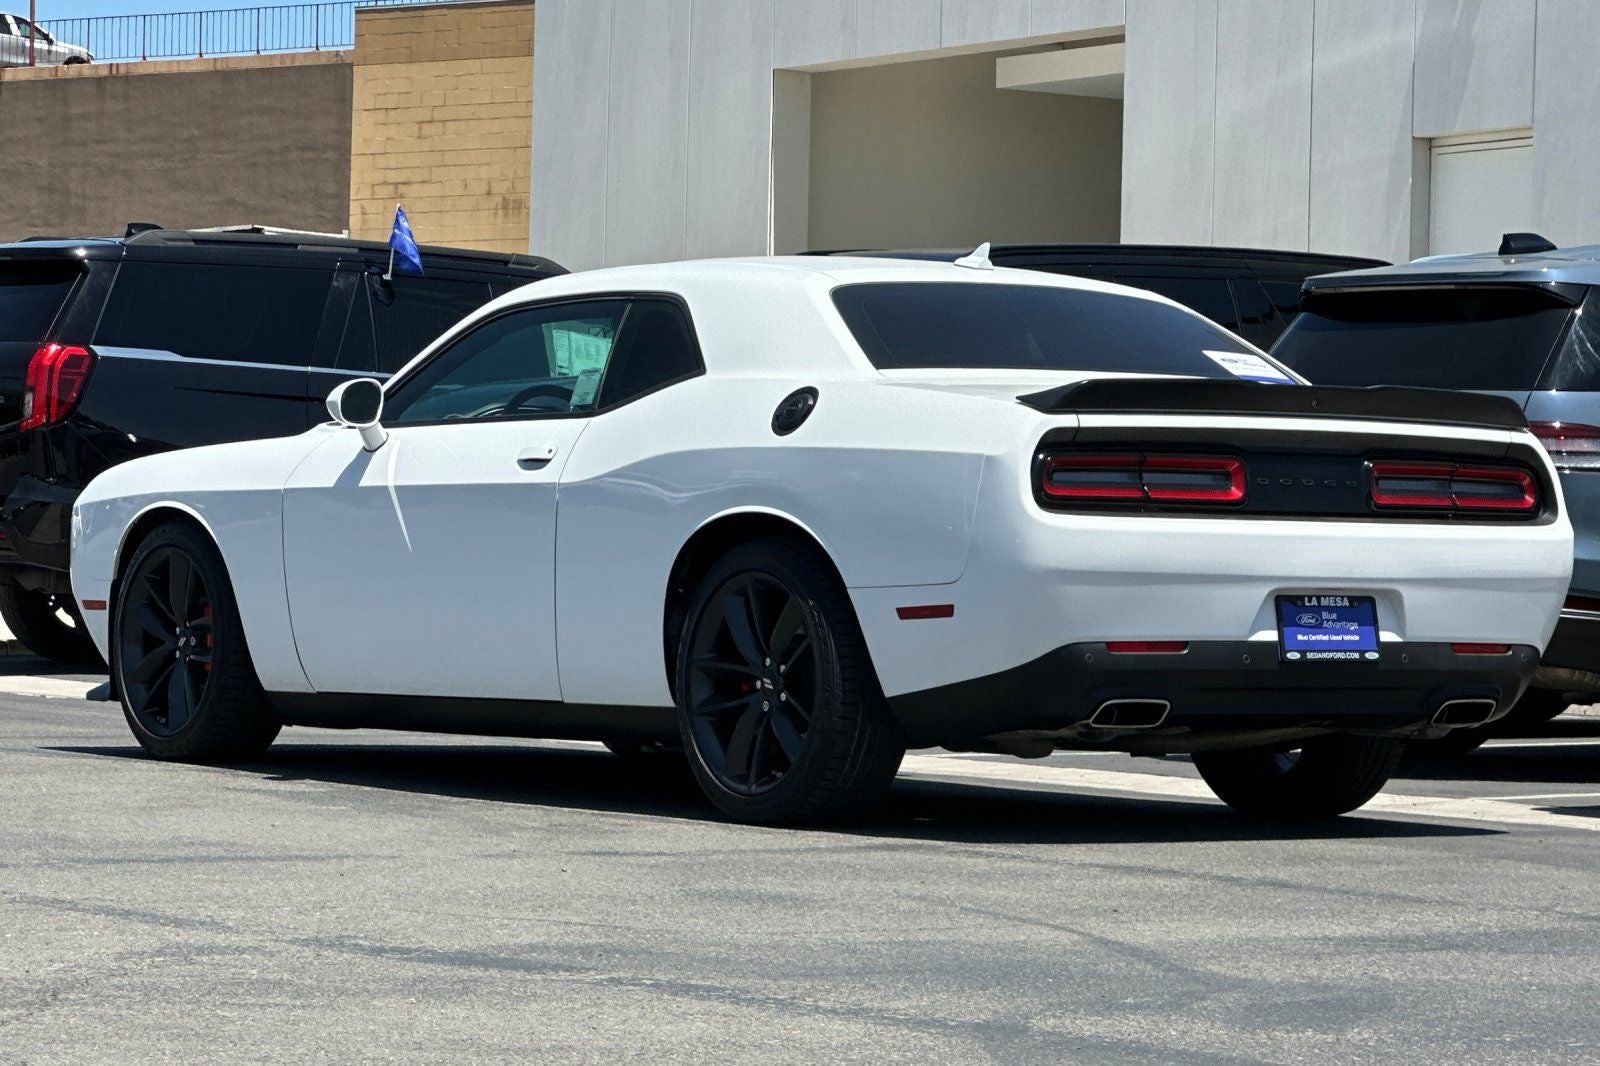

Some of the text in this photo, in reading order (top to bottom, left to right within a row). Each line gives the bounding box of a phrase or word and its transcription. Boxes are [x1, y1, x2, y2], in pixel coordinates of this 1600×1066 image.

[1304, 597, 1350, 607] LA MESA
[1322, 611, 1337, 620] Blue
[1322, 620, 1359, 630] Advantage
